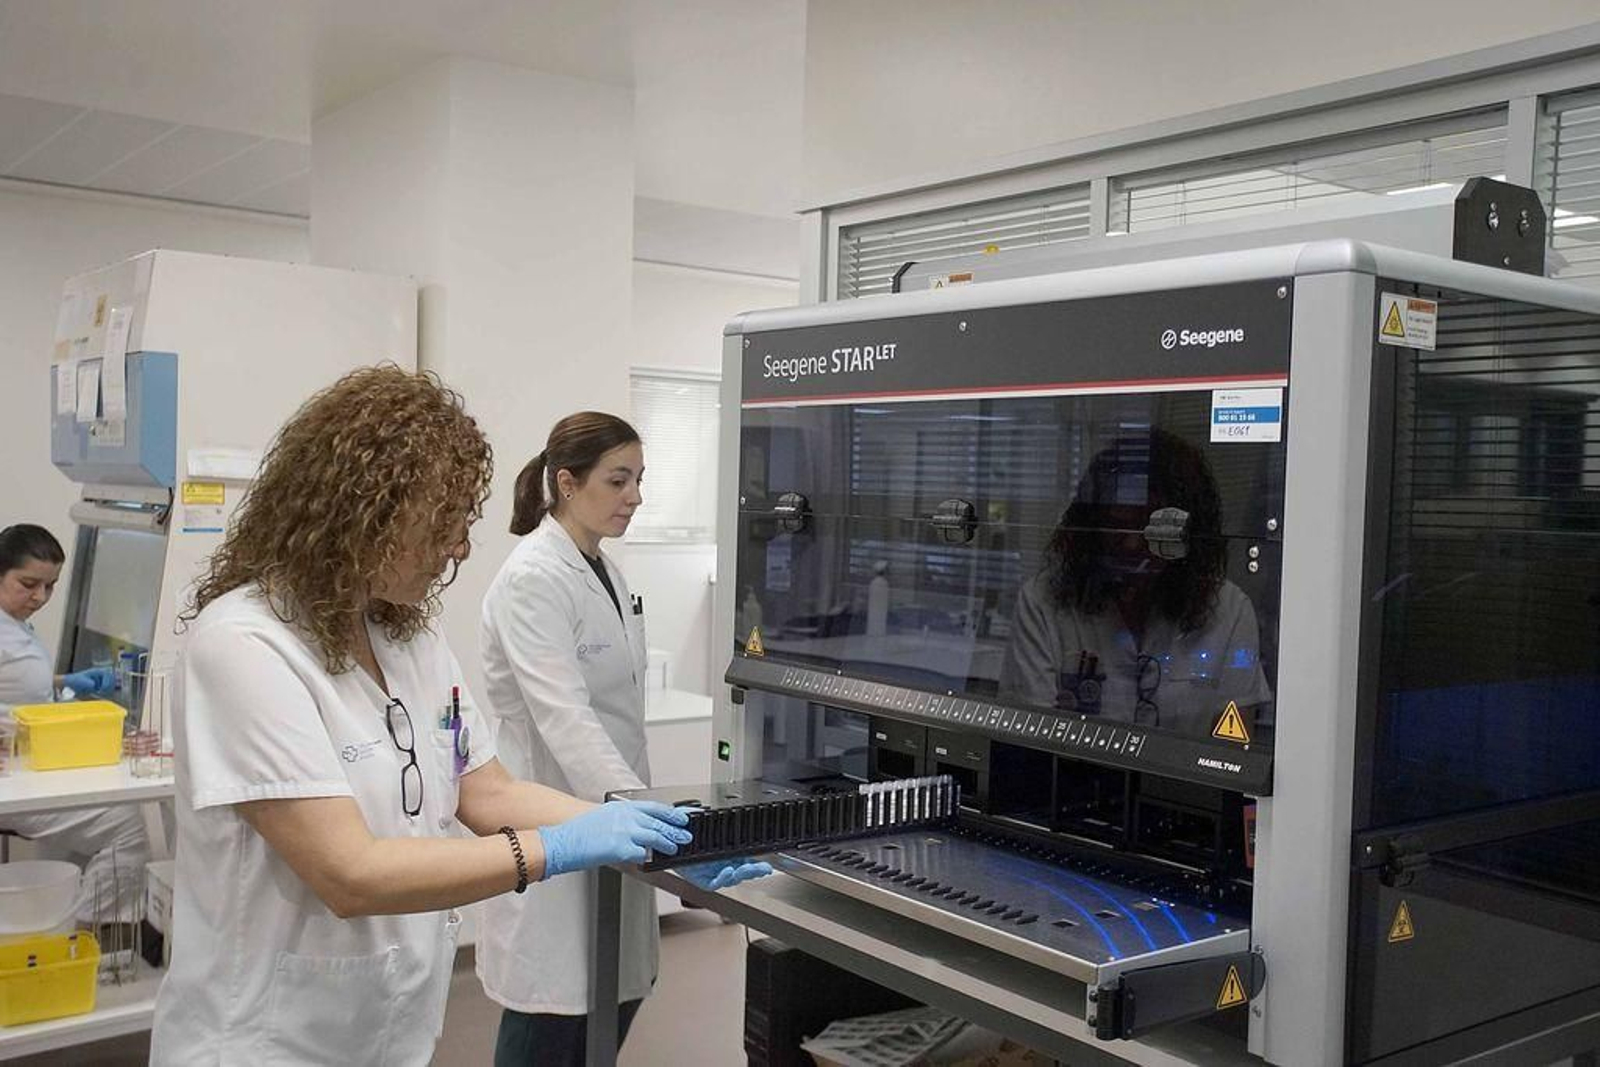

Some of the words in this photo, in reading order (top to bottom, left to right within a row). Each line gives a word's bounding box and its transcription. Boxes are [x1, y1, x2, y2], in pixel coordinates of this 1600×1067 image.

[1180, 328, 1244, 348] Seegene
[763, 354, 827, 382] Seegene
[1197, 757, 1242, 773] HAMILTON
